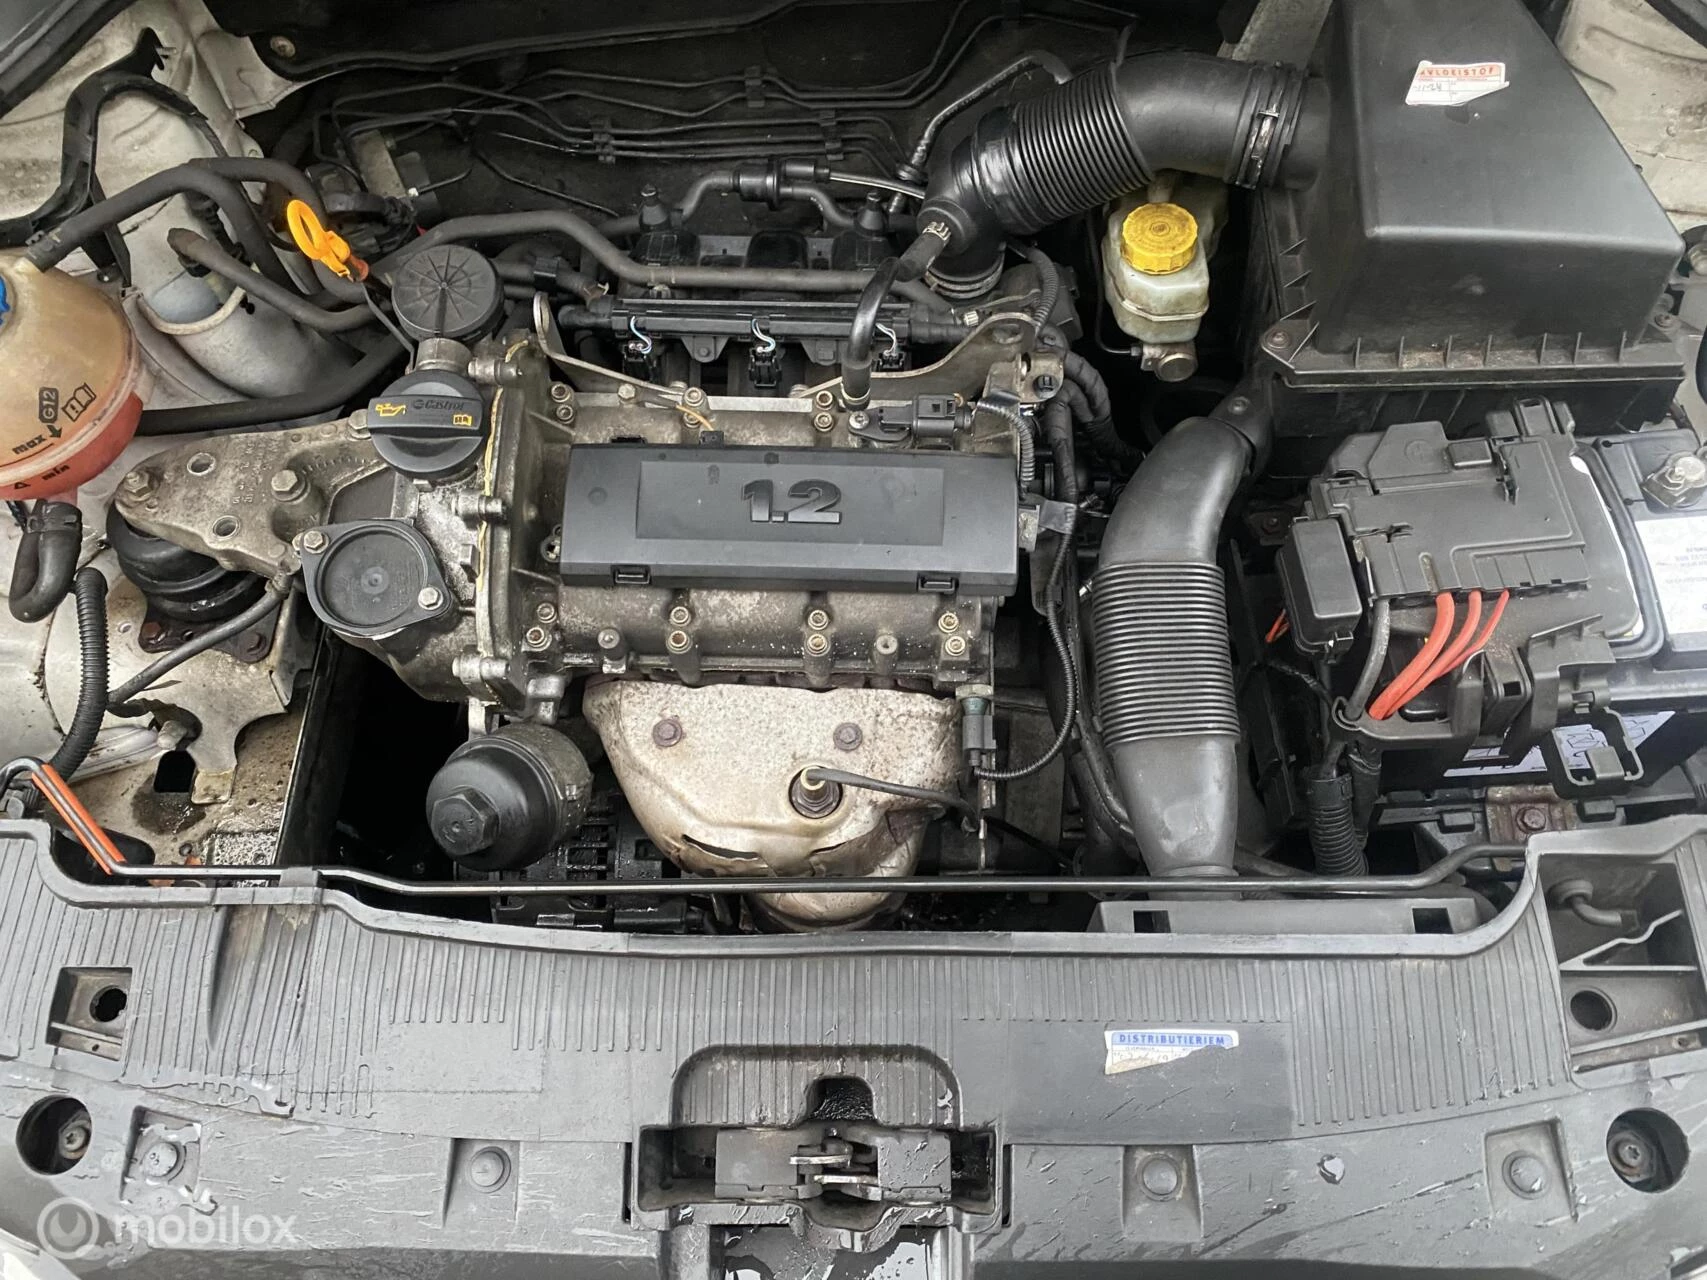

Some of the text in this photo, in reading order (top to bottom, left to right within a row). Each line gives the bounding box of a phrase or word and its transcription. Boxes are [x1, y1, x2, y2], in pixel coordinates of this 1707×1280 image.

[42, 390, 56, 420] G12
[425, 399, 465, 411] Castrol
[12, 434, 47, 455] max
[41, 464, 71, 481] min
[743, 479, 842, 524] 1.2
[1119, 1034, 1225, 1045] DISTRIBUTIERIEM
